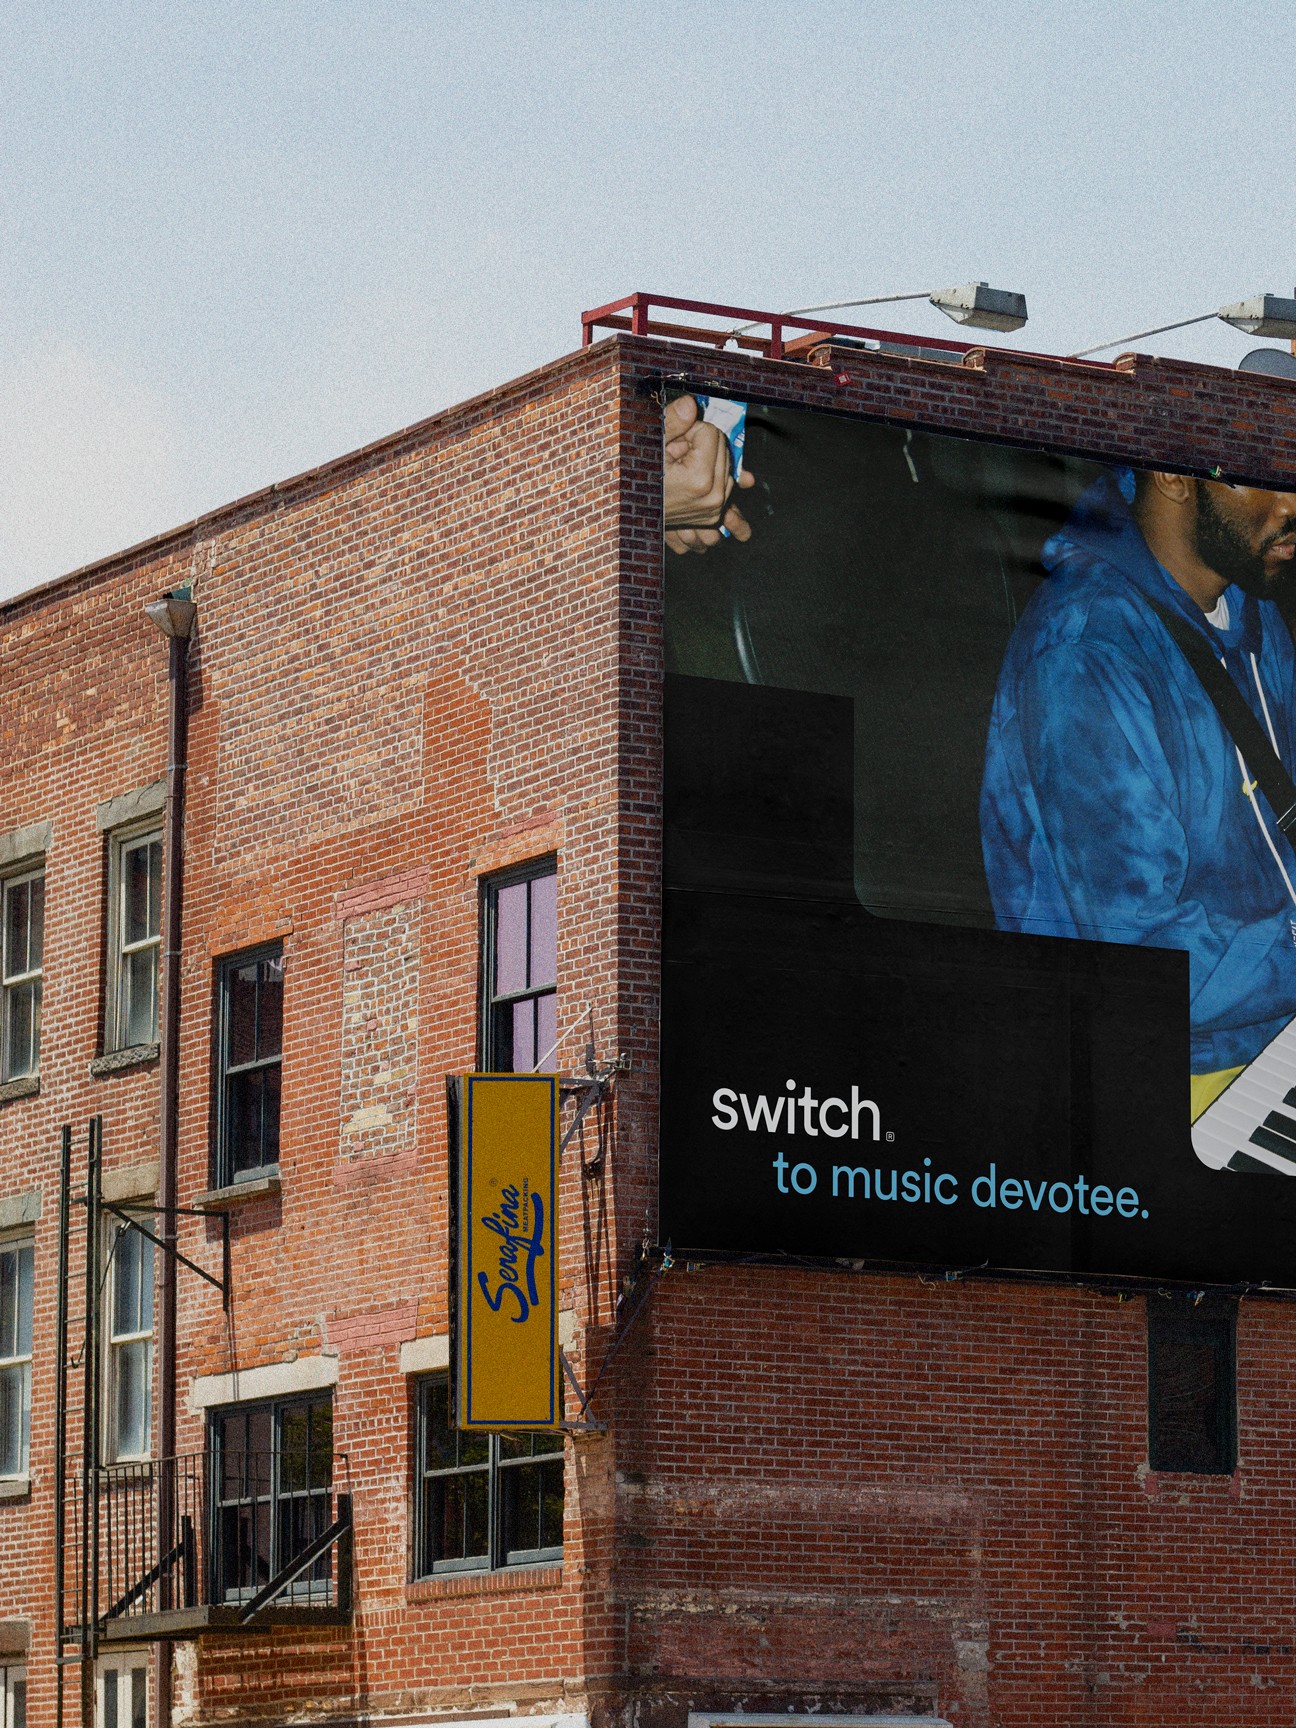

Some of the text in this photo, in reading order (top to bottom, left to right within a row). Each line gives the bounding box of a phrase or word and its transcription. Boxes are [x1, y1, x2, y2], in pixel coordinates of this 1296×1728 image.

[773, 1147, 1149, 1219] to music devotee.
[478, 1183, 544, 1324] Serafina
